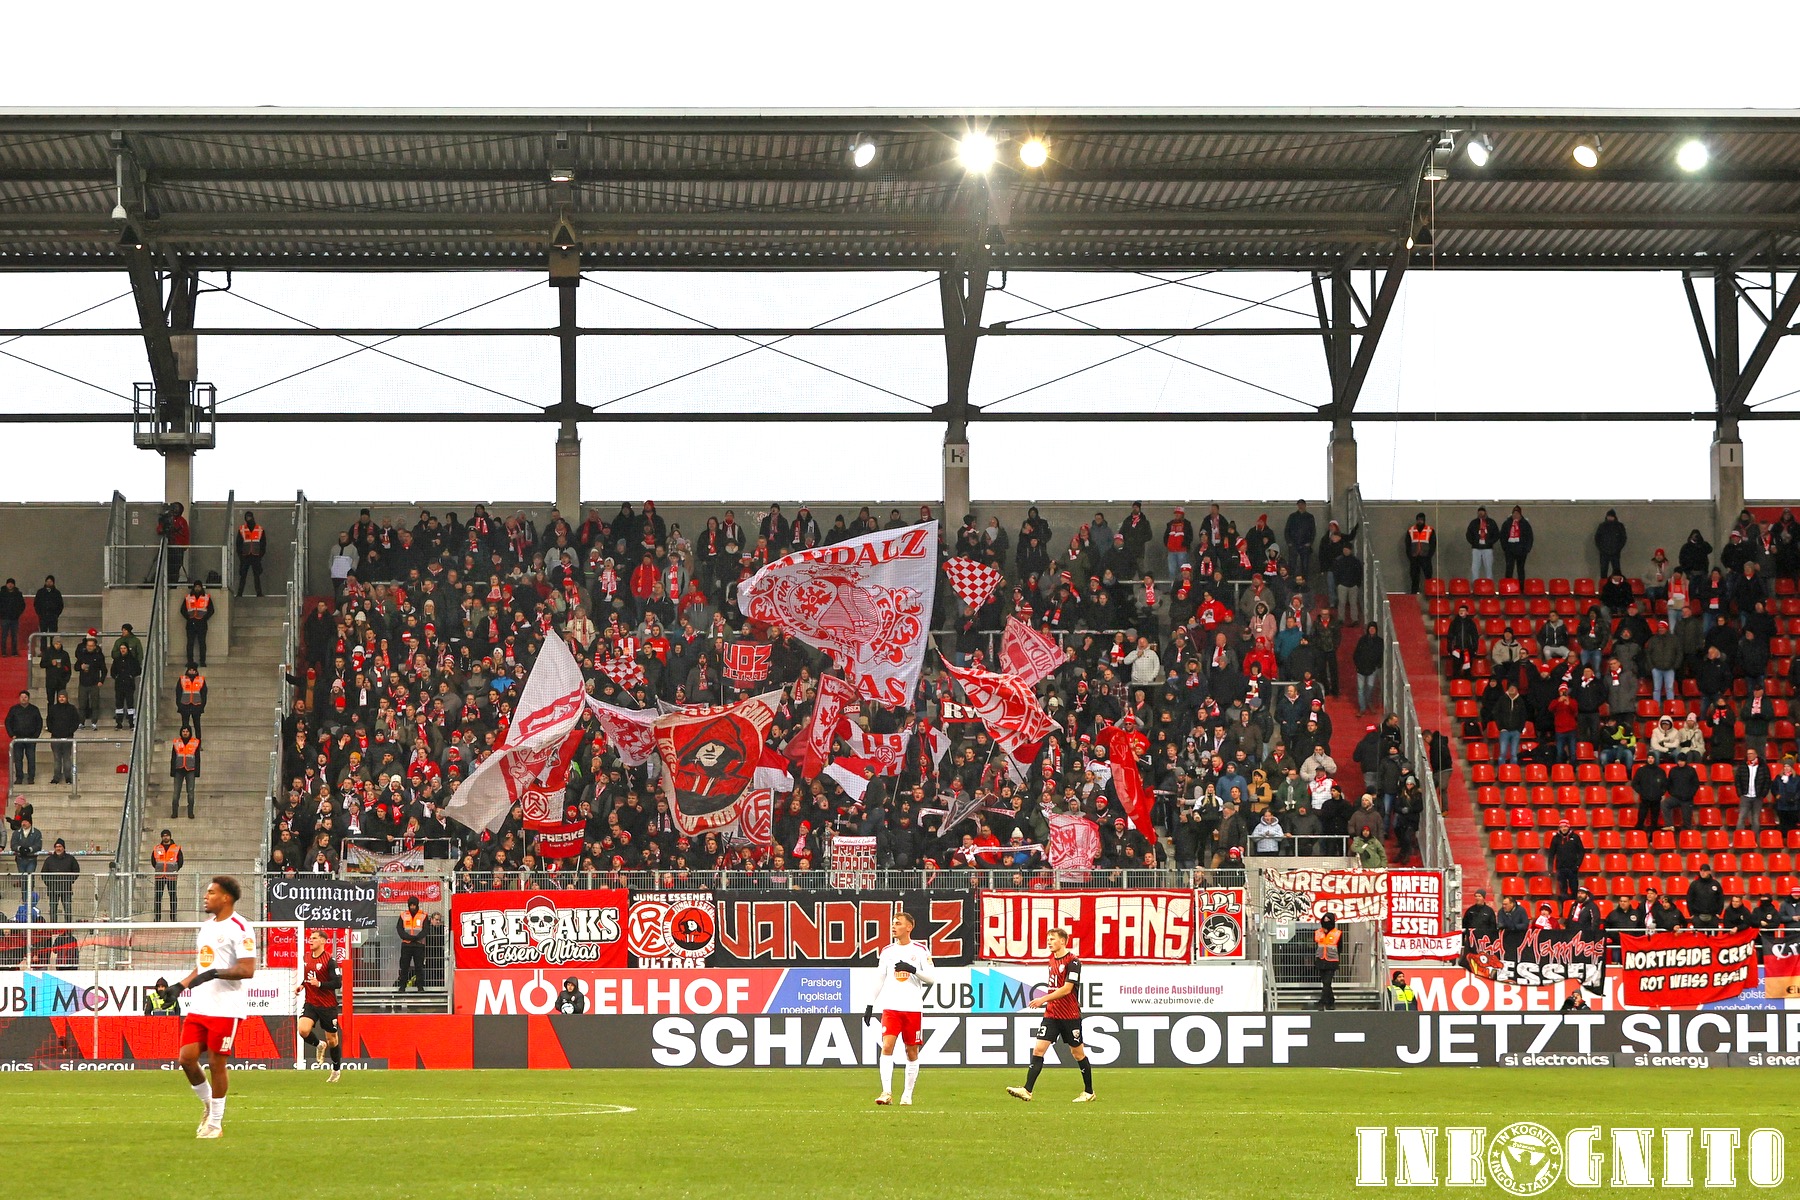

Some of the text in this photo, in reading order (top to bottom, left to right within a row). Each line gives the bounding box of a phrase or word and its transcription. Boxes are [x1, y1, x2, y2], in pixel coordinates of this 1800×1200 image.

[540, 828, 585, 842] FREAKS
[830, 872, 877, 890] VEROT
[1267, 869, 1388, 894] WRECKING
[1391, 875, 1439, 893] HAFEN
[272, 882, 376, 901] Commando
[633, 893, 713, 902] JUNGE ESSENER
[294, 902, 353, 922] Essen
[1199, 892, 1241, 914] LPL
[1314, 895, 1381, 919] CREW
[1391, 895, 1439, 912] SÄNGER
[460, 908, 621, 947] FREAKS
[983, 896, 1191, 960] RUDE FANS
[1391, 917, 1439, 936] ESSEN
[273, 935, 299, 945] Cedri
[1393, 938, 1406, 949] LA
[1410, 938, 1444, 949] BANDA
[1517, 928, 1606, 964] Mambas
[486, 938, 600, 966] Essen Ultras
[1625, 946, 1712, 970] NORTHSIDE
[638, 957, 706, 969] ULTRAS
[1497, 960, 1603, 987] ESSEN
[1640, 975, 1665, 991] ROT
[1669, 973, 1709, 989] WEISS
[801, 978, 842, 988] Parsberg
[1119, 985, 1224, 996] Finde deine Ausbildung!
[247, 987, 279, 999] ildung!
[797, 991, 842, 1002] Ingolstadt
[921, 983, 984, 1010] ZUBI
[1130, 996, 1215, 1005] www.azubimovie.de
[780, 1005, 842, 1014] moebelhof.de
[1080, 1015, 1311, 1065] STOFF
[1396, 1014, 1606, 1064] JETZT
[1504, 1054, 1610, 1066] si electronics
[1635, 1053, 1709, 1069] si energy
[1749, 1053, 1763, 1066] si
